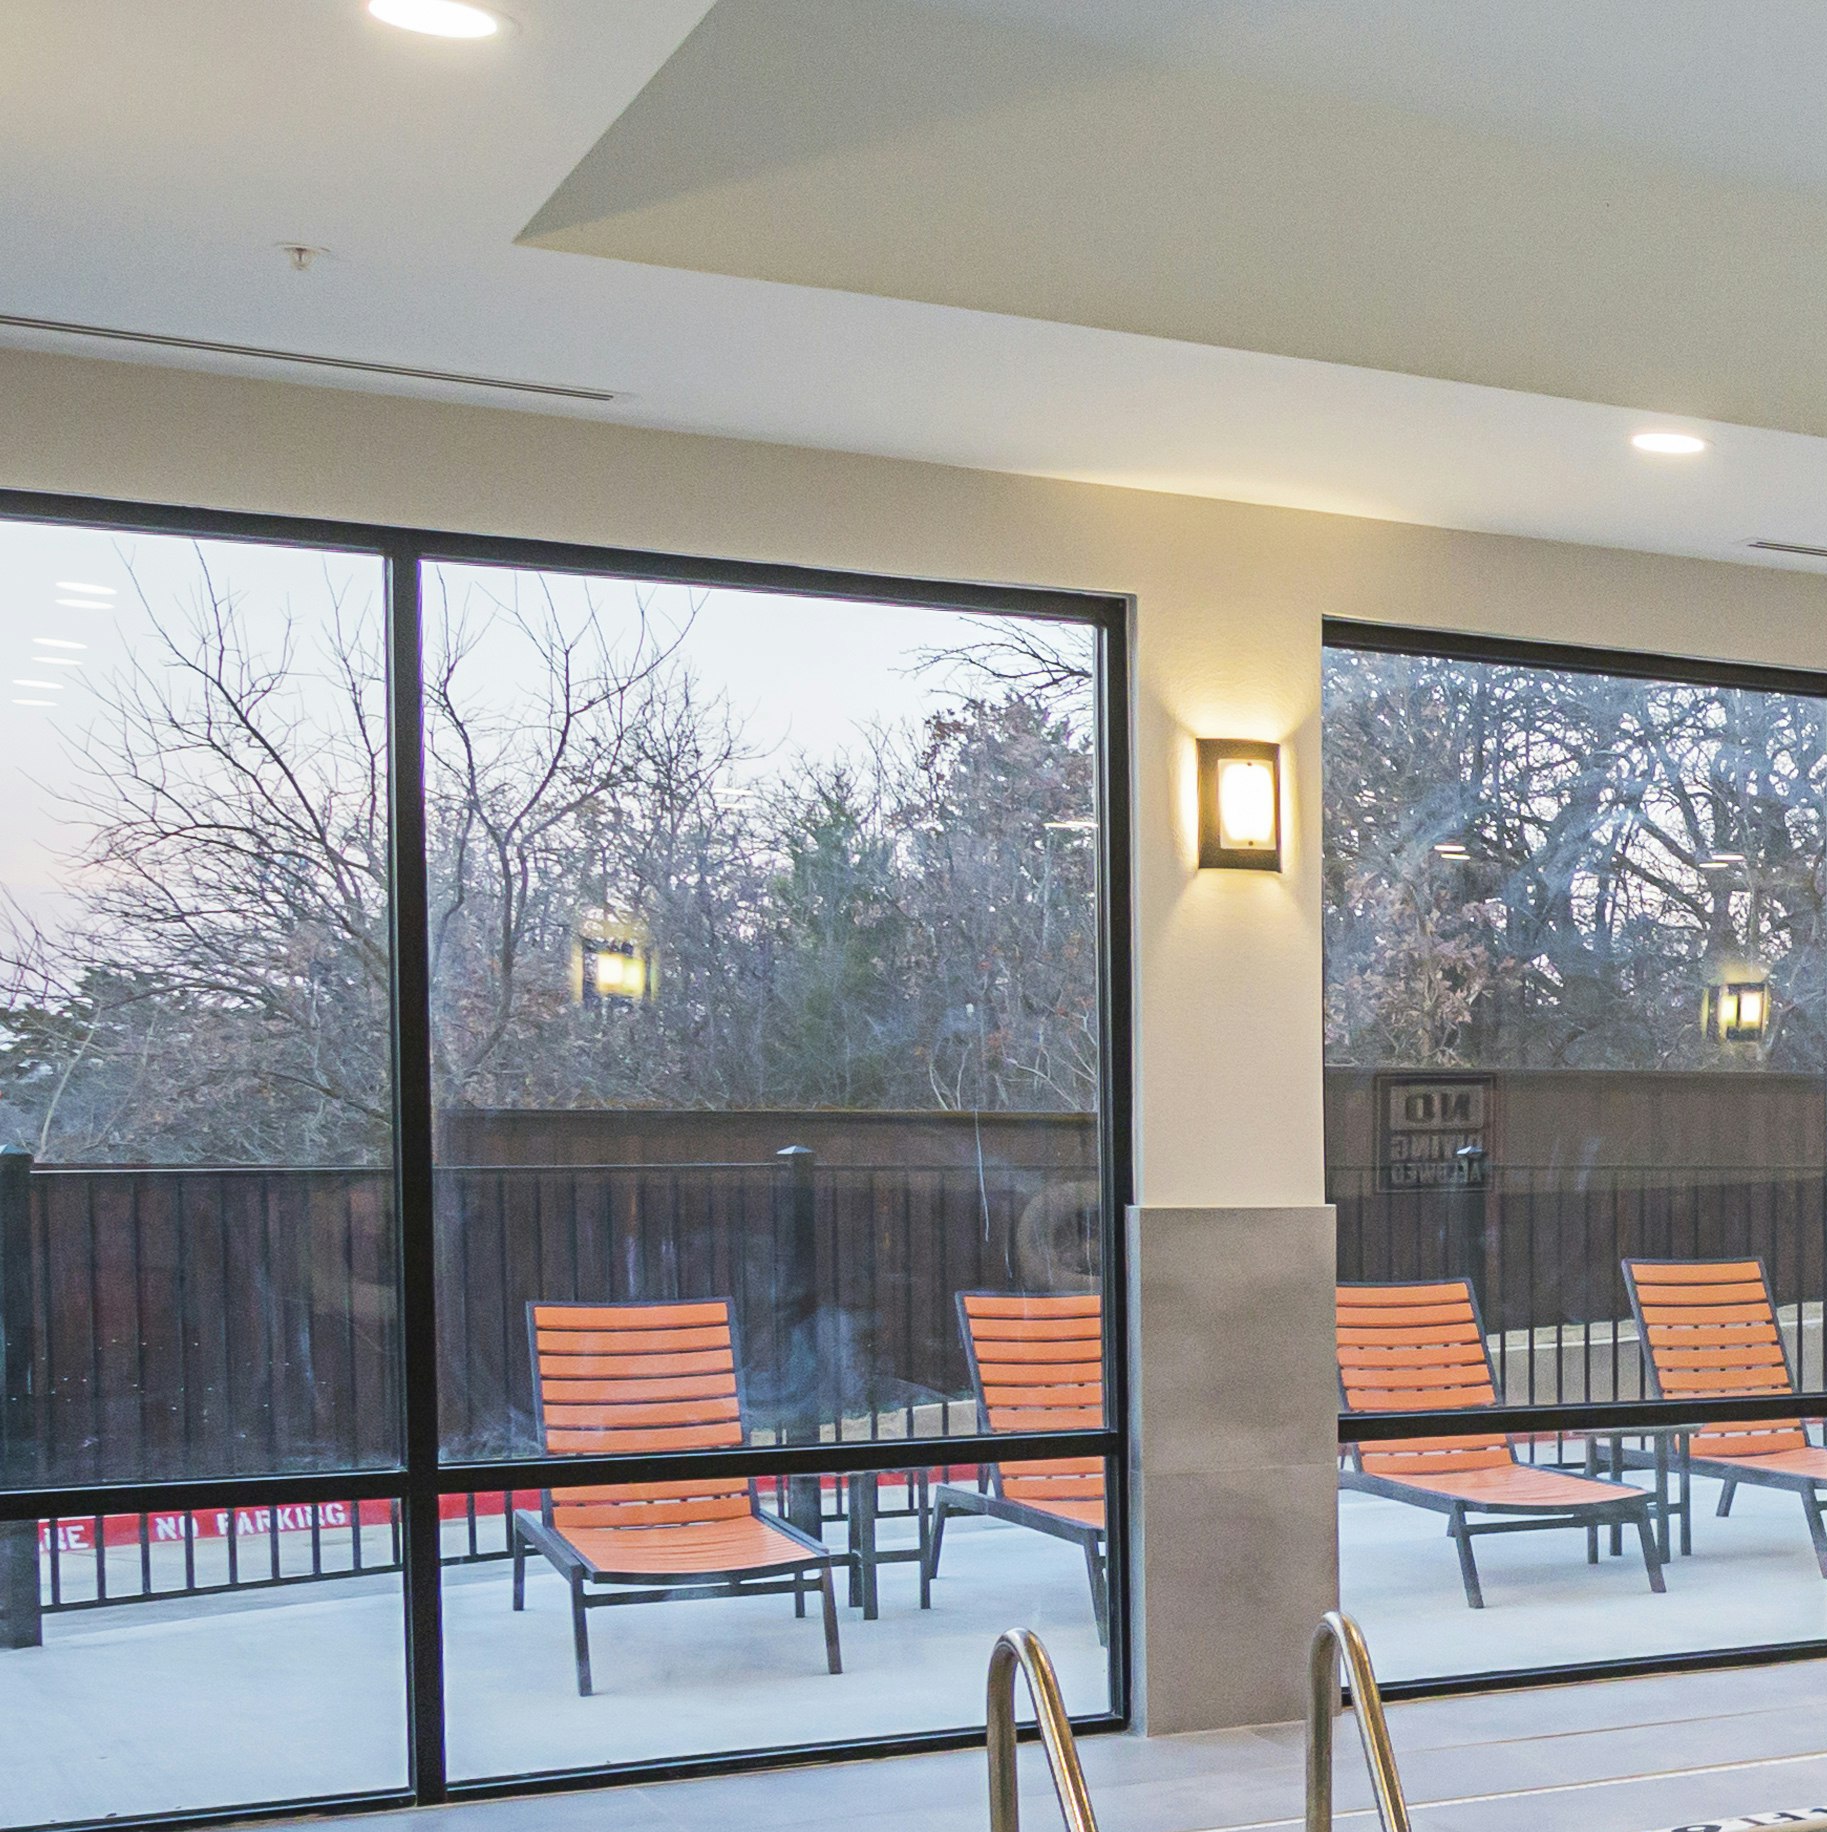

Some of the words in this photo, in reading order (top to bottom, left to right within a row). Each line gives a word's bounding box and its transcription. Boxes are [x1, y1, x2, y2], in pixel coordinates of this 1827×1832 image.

[39, 1525, 90, 1550] NE
[154, 1516, 199, 1540] NO
[216, 1503, 346, 1536] PARKING
